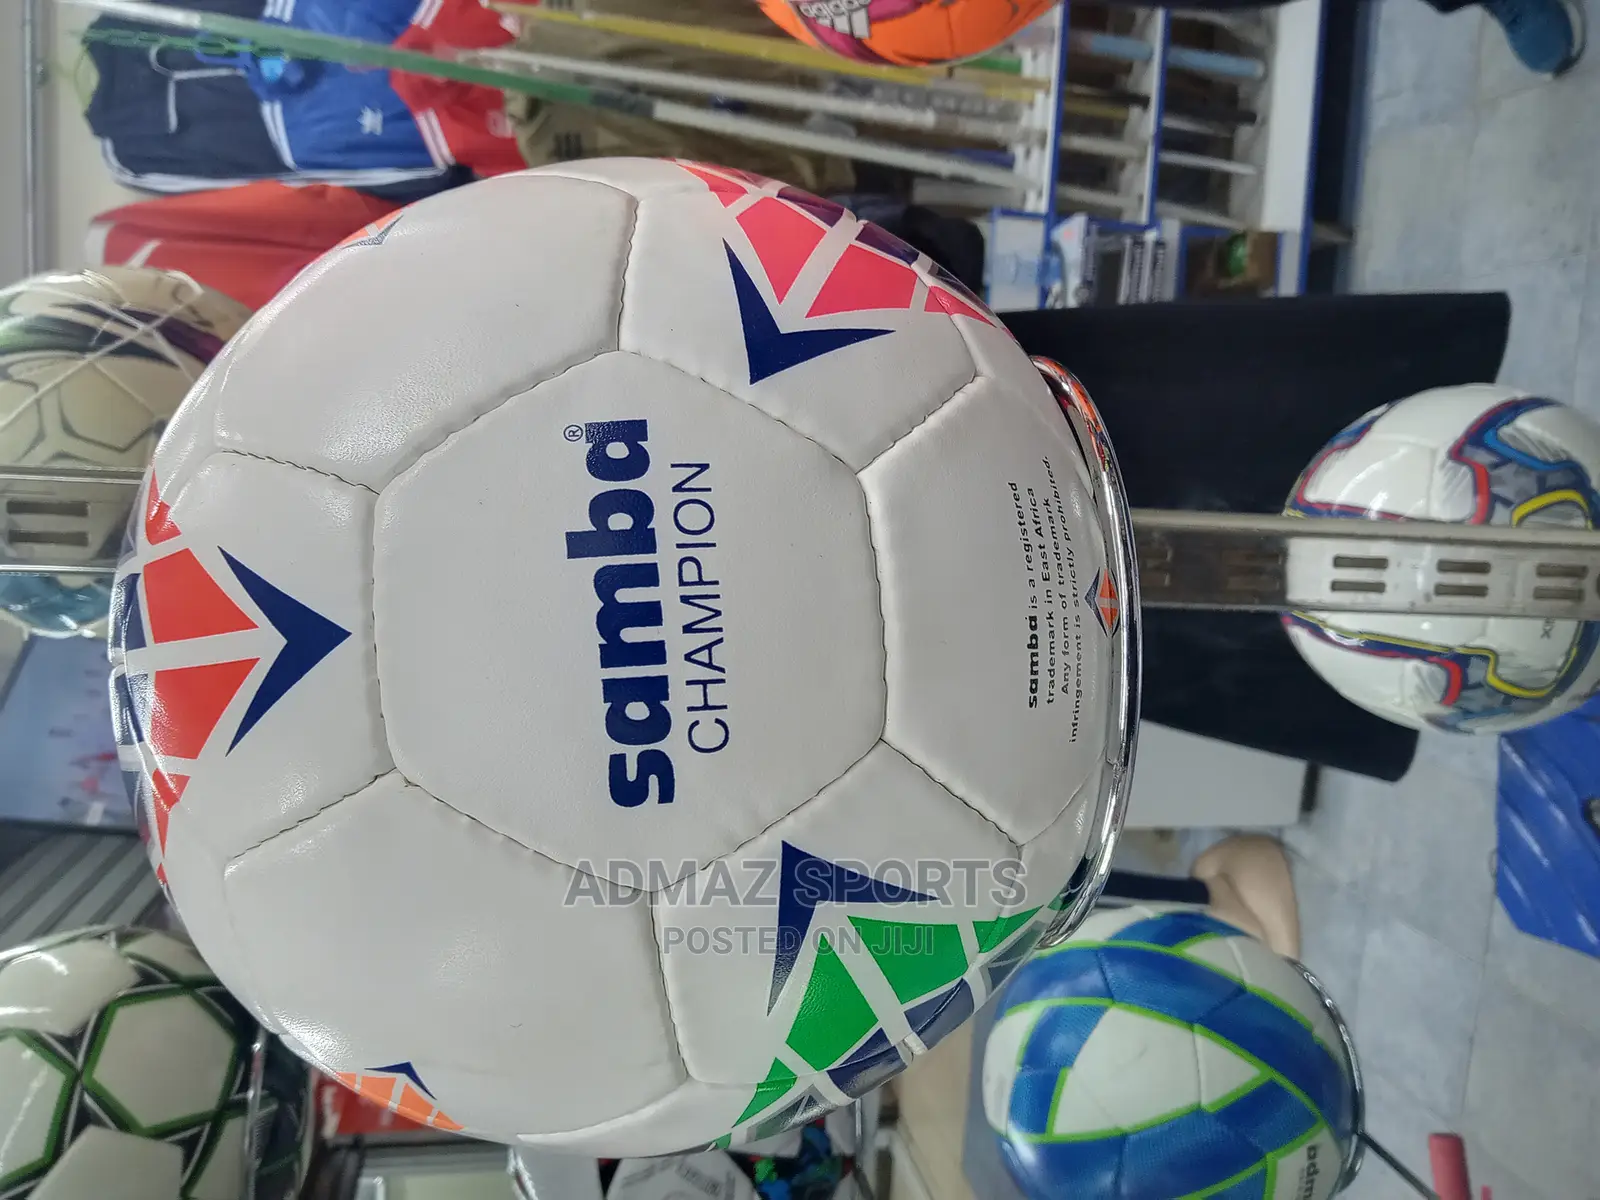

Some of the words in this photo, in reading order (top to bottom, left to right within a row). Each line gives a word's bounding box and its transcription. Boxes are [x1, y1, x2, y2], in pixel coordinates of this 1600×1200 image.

[1027, 488, 1044, 538] Africa
[1042, 456, 1072, 541] prohibited.
[1008, 482, 1033, 572] registered
[1043, 498, 1065, 585] trademark
[1028, 579, 1036, 588] a
[1038, 543, 1051, 582] East
[1066, 547, 1080, 607] strictly
[670, 463, 729, 753] CHAMPION
[1029, 595, 1038, 609] is
[1045, 589, 1053, 604] in
[1059, 593, 1068, 610] of
[1074, 614, 1081, 628] is
[1046, 611, 1056, 704] trademark
[1062, 616, 1070, 656] form
[1025, 615, 1039, 708] samba
[1061, 662, 1071, 694] Any
[1069, 634, 1083, 743] infringement
